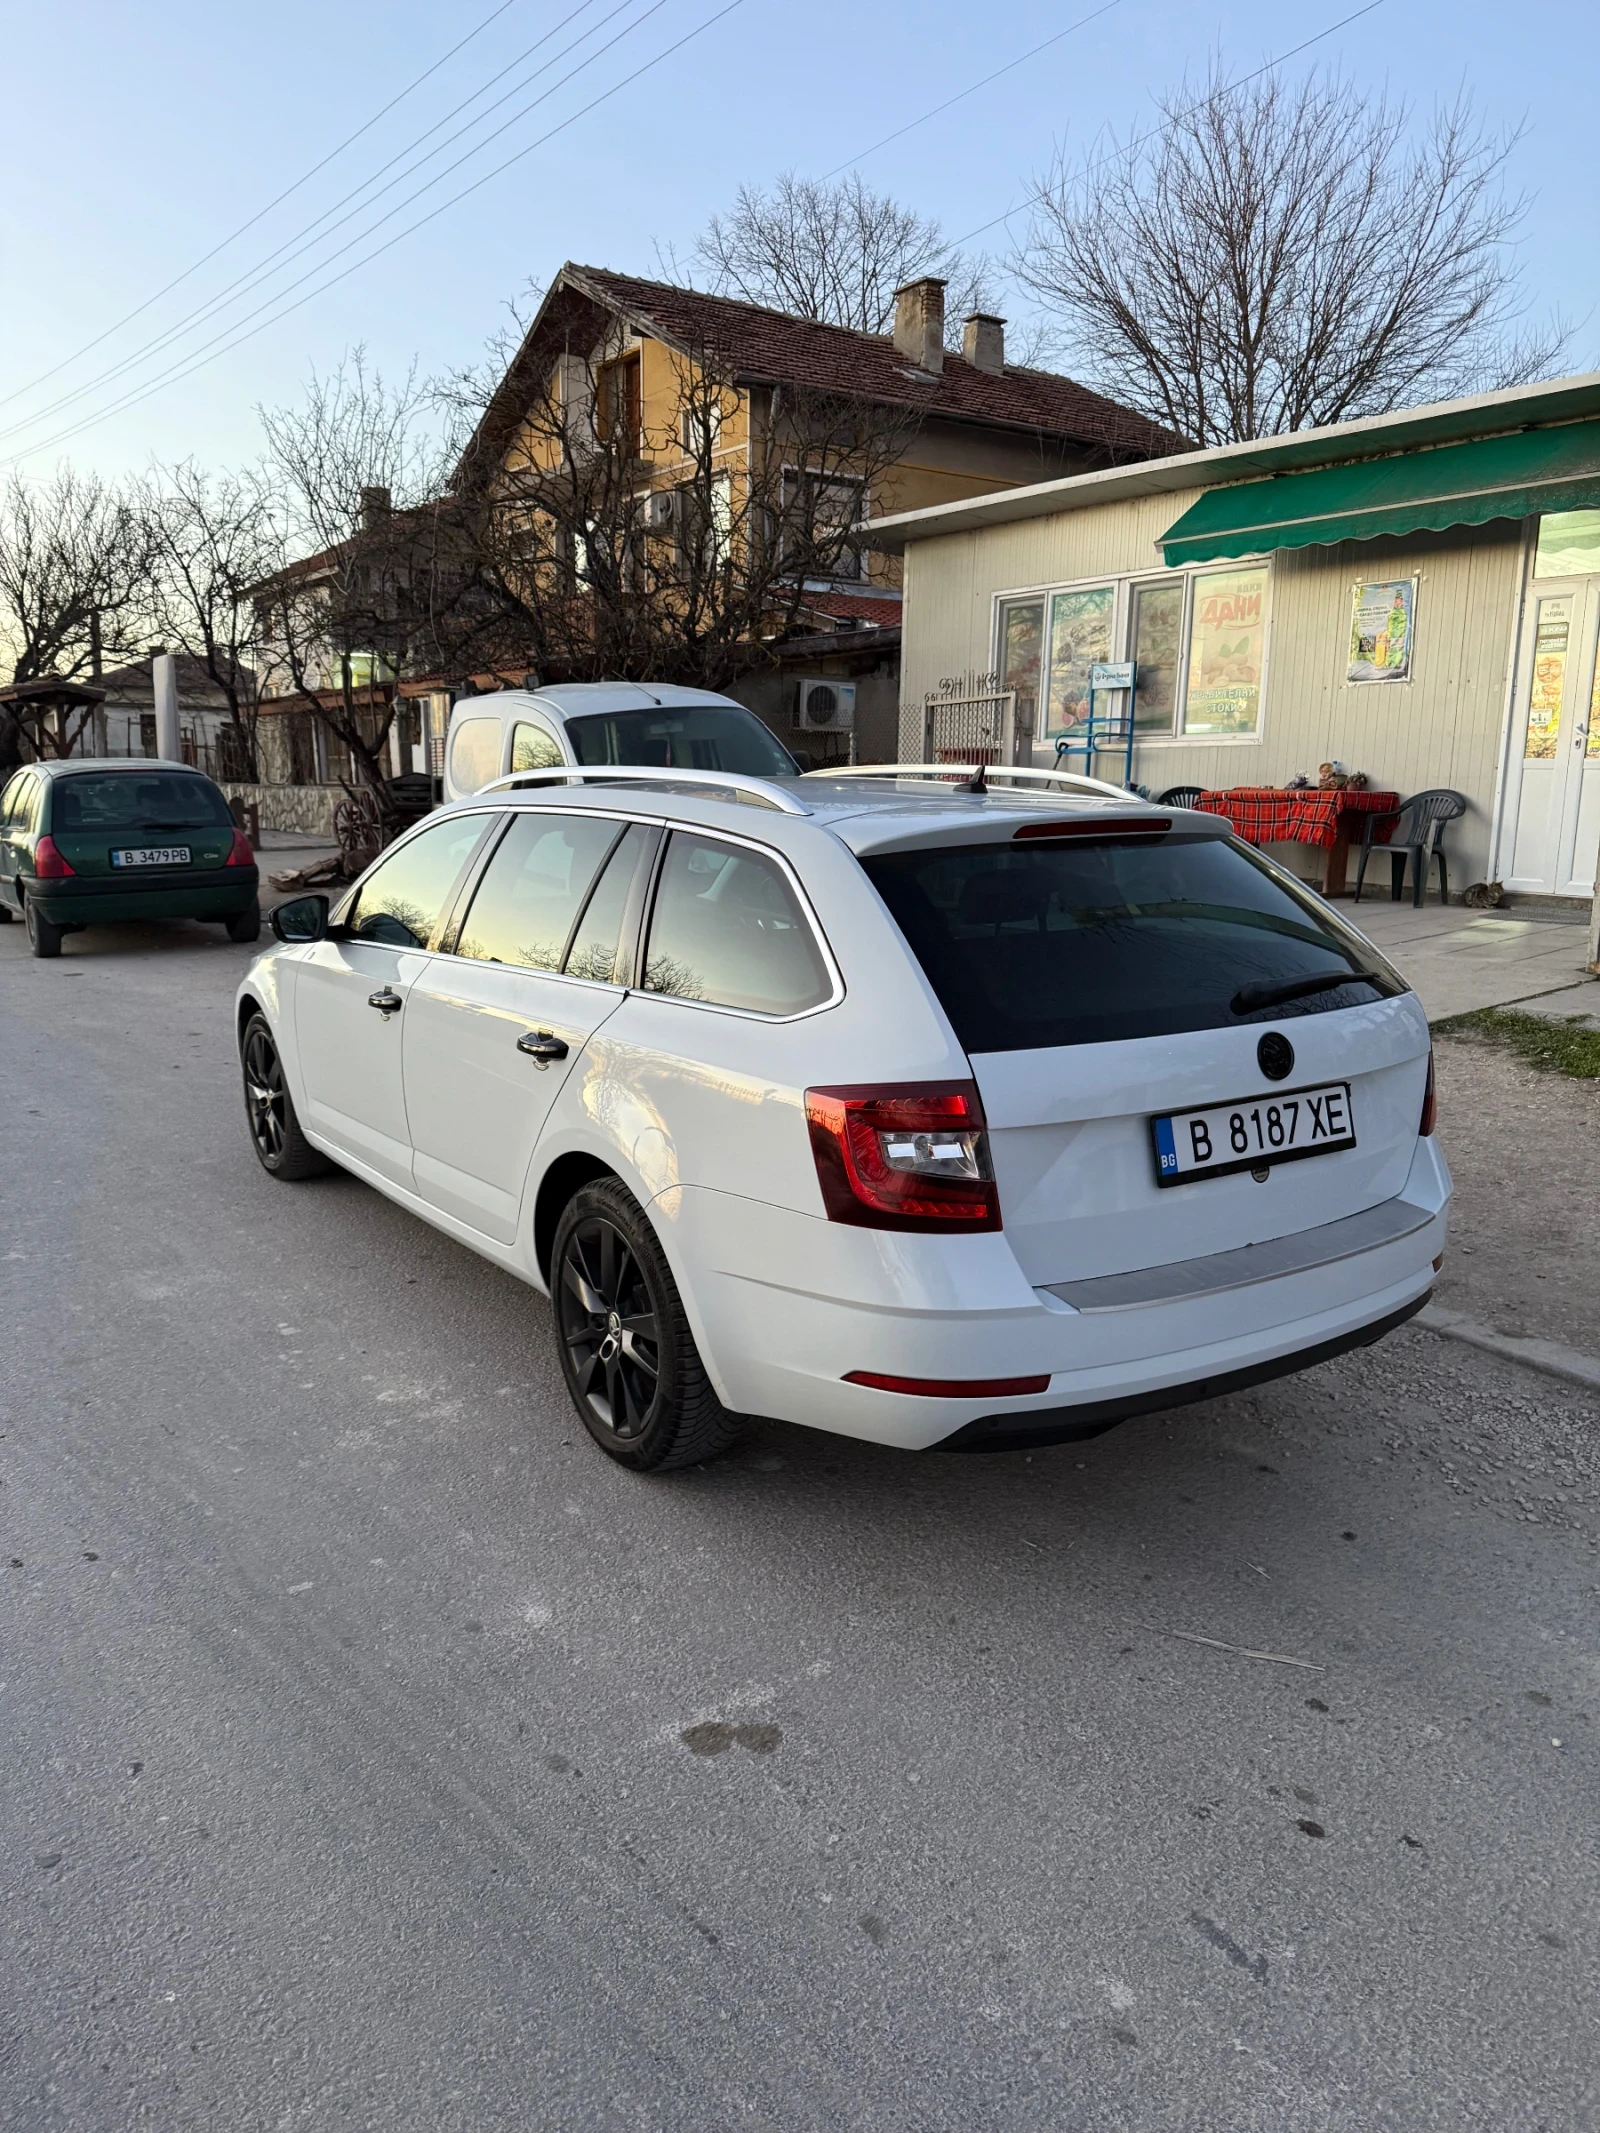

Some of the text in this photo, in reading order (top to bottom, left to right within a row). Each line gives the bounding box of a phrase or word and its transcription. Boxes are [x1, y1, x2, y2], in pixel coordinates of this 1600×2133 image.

[1199, 592, 1262, 630] ДАНИ
[1204, 701, 1237, 714] СТОКИ
[140, 850, 169, 863] 3479
[171, 849, 188, 861] PB
[1189, 1093, 1347, 1163] B 8187 XE
[1161, 1153, 1177, 1169] BG
